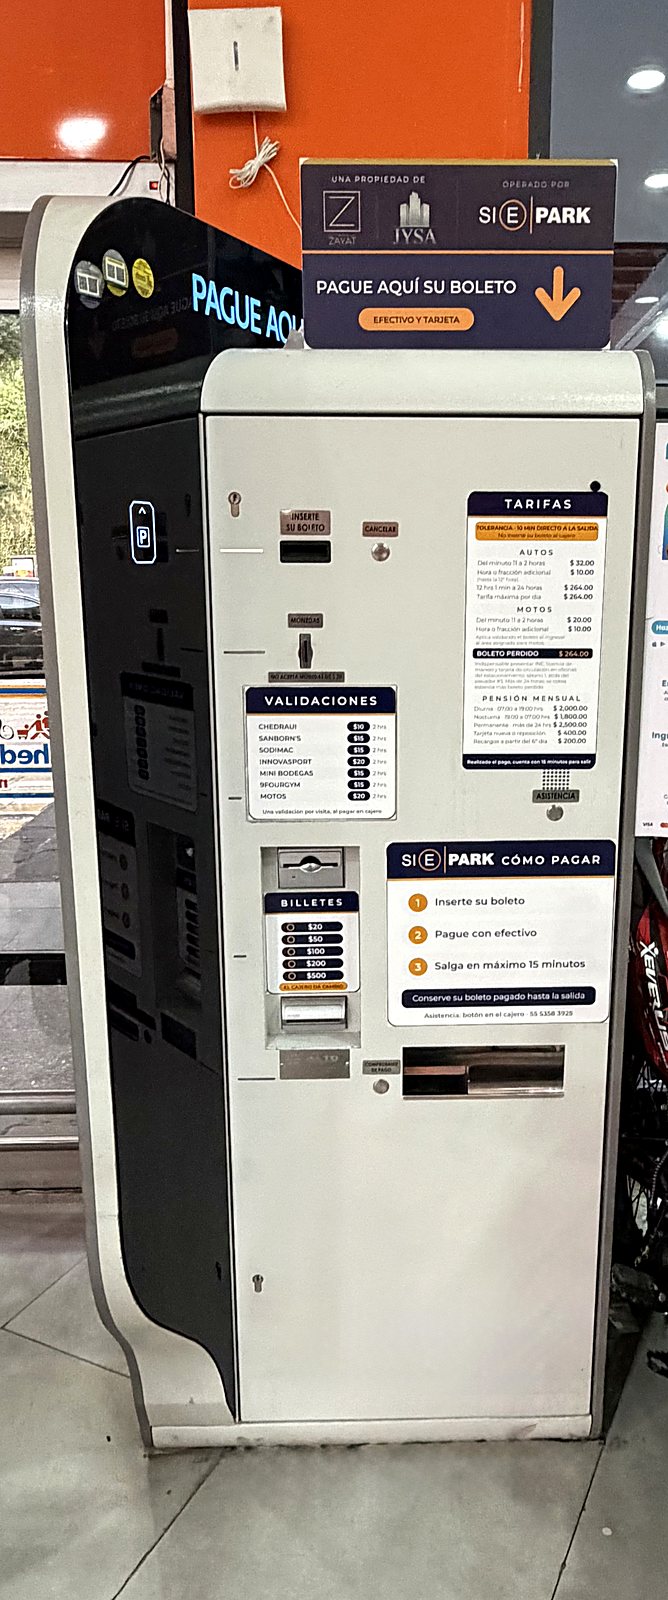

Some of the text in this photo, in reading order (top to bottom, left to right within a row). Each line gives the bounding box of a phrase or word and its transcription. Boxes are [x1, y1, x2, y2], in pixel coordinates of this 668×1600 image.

[355, 176, 410, 185] PROPIEDAD
[413, 176, 426, 184] DE
[503, 181, 570, 189] OPERADO POR
[393, 228, 437, 245] JYSA
[316, 277, 516, 297] PAGUE AQUÍ SU BOLETO
[192, 272, 262, 335] PAGUE
[373, 316, 460, 325] EFECTIVO Y TARJETA
[505, 499, 572, 509] TARIFAS
[291, 513, 320, 521] INSERTE
[264, 696, 377, 706] VALIDACIONES
[482, 694, 528, 702] PENSIÓN
[501, 853, 545, 866] CÓMO
[551, 855, 601, 866] PAGAR
[281, 898, 343, 908] BILLETES
[435, 897, 473, 907] Inserte
[491, 897, 525, 906] boleto
[414, 928, 537, 940] 2 Pague con efectivo
[414, 963, 422, 972] 3
[434, 961, 464, 972] Salga
[483, 960, 526, 970] máximo
[529, 960, 539, 969] 15
[541, 960, 586, 969] minutos
[412, 994, 452, 1003] Conserve
[465, 993, 492, 1001] boleto
[493, 993, 526, 1003] pagado
[552, 992, 560, 1000] la
[561, 992, 585, 1000] salida
